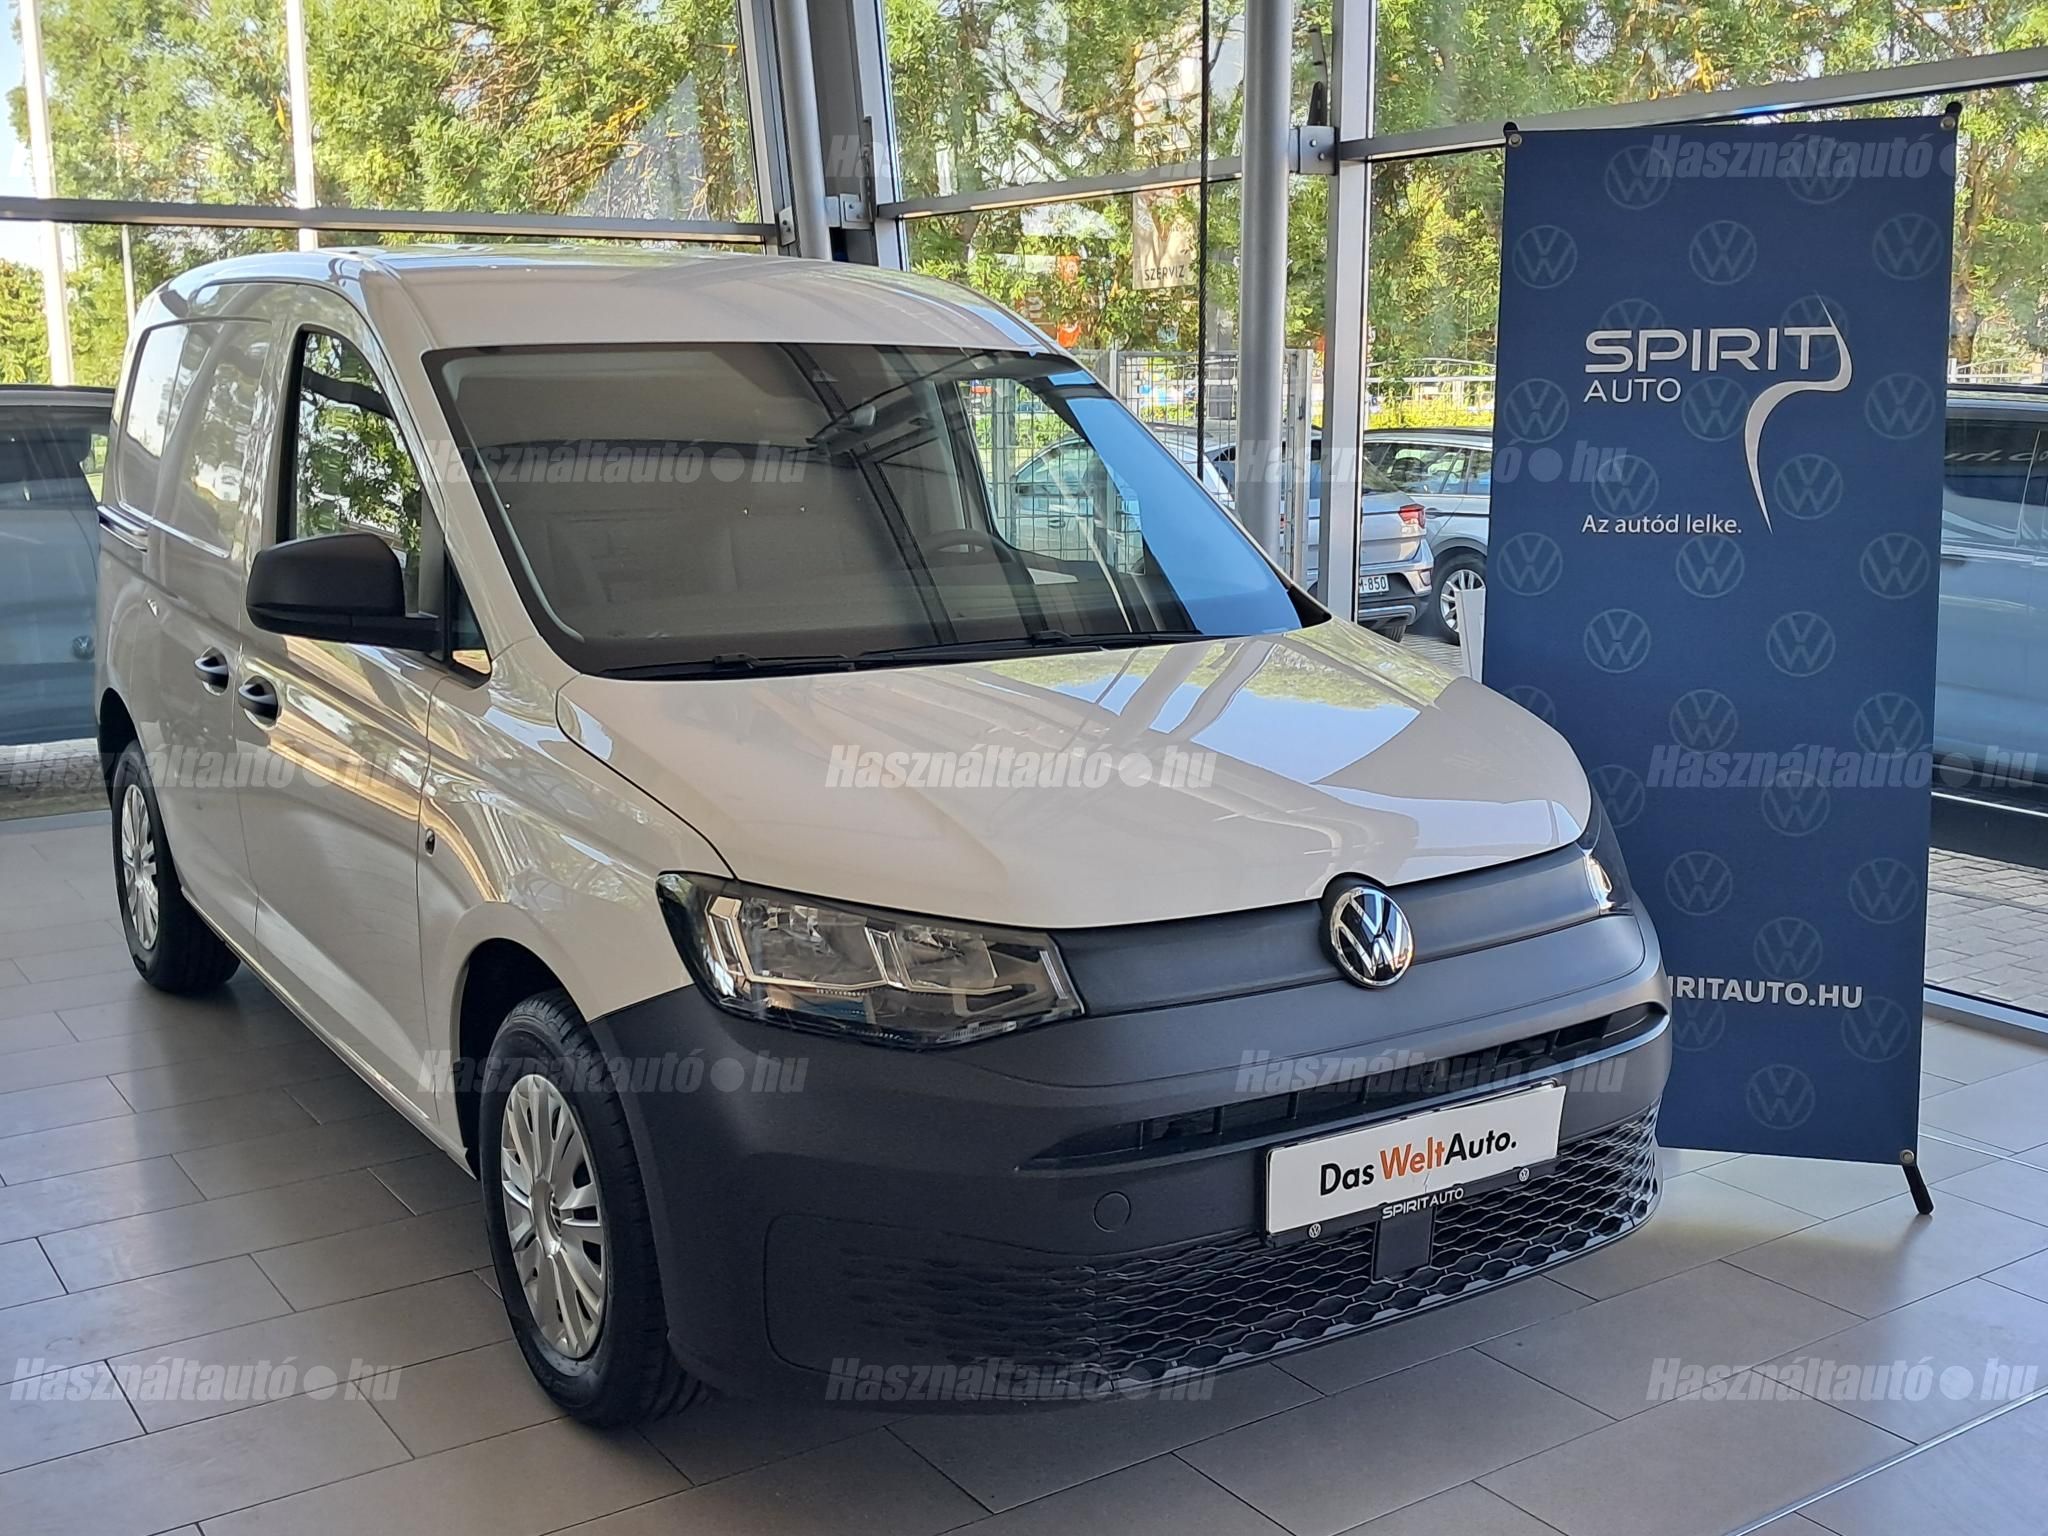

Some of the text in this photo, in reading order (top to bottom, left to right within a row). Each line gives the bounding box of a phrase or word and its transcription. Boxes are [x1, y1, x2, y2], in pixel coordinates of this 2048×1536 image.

[1144, 265, 1185, 282] SZERVIZ
[1584, 327, 1838, 373] SPIRIT
[1584, 378, 1682, 403] AUTO
[1582, 513, 1743, 534] Az autód lelke.
[1320, 1162, 1375, 1196] Das
